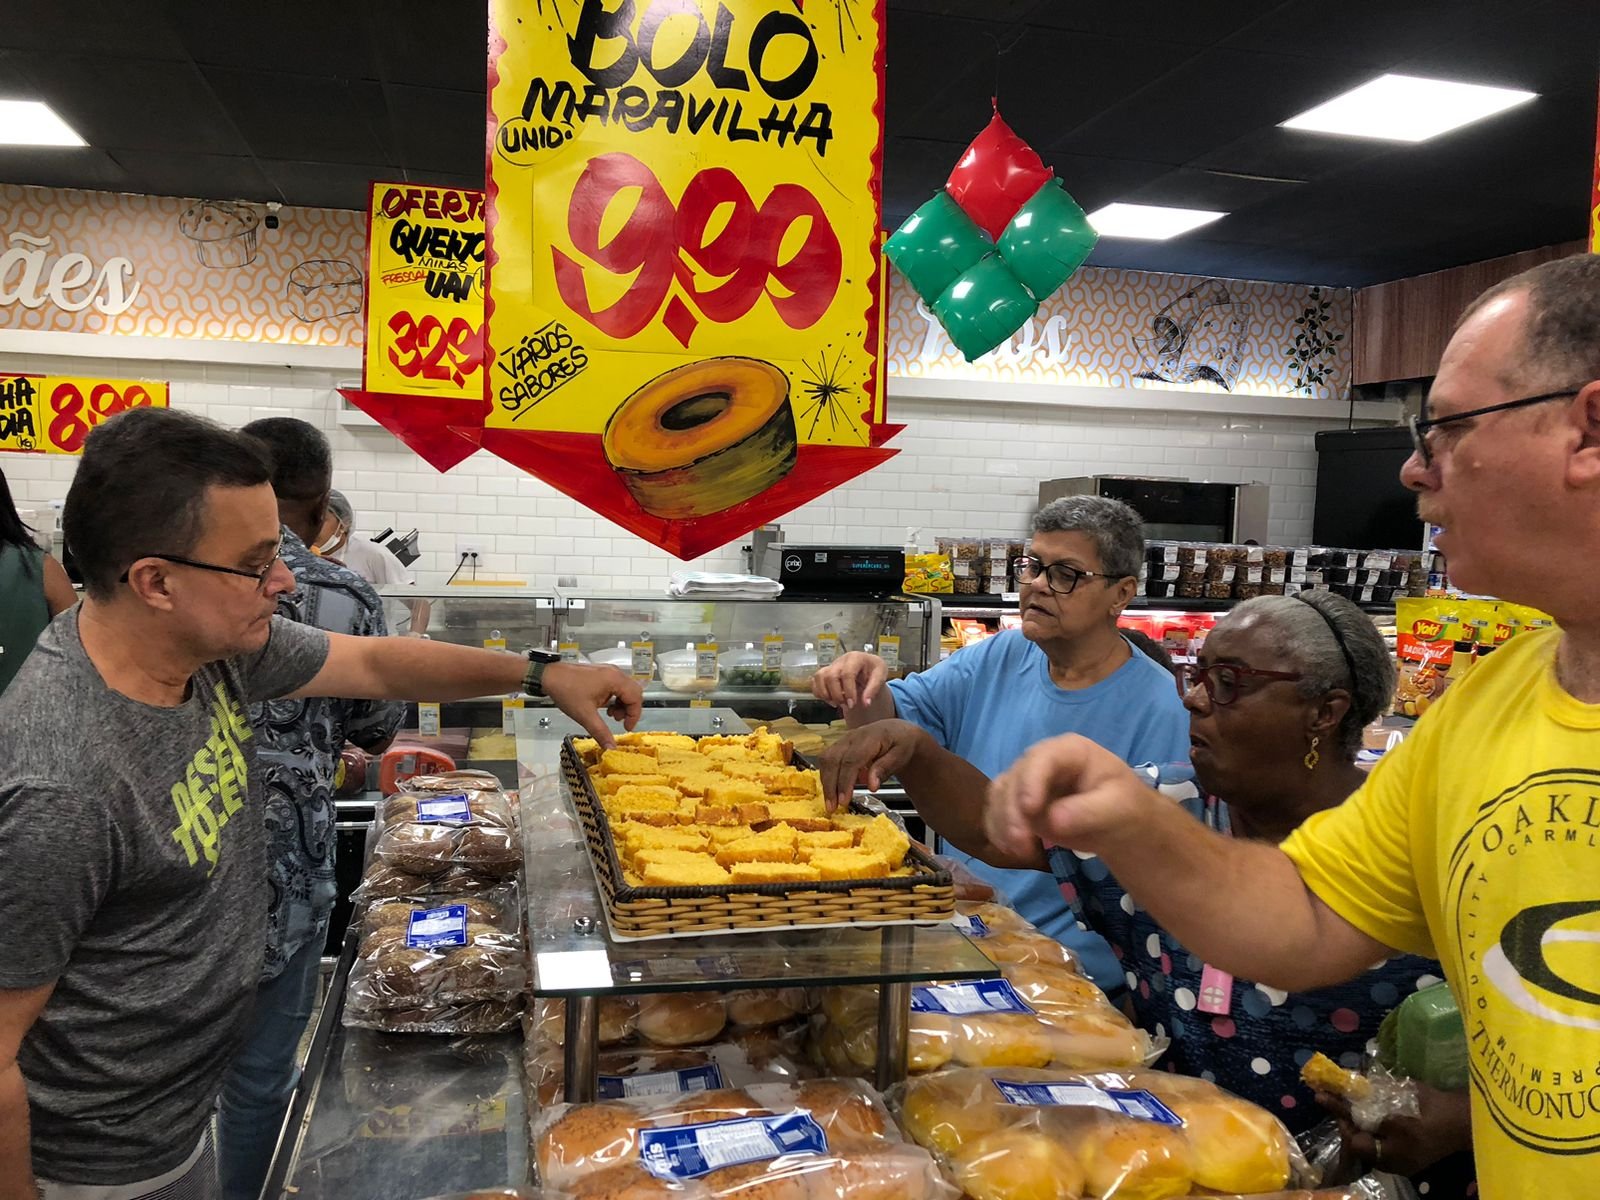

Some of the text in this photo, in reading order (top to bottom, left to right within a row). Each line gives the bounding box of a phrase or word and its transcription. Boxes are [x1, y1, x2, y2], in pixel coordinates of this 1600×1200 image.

[566, 0, 819, 101] BOLO
[520, 77, 834, 158] MARAVILHA
[425, 269, 474, 303] UAI
[551, 152, 843, 349] 9,99
[387, 310, 485, 390] 32,9
[498, 323, 573, 379] VÁRIOS
[500, 346, 588, 411] SABORES
[1415, 620, 1441, 636] Yoki
